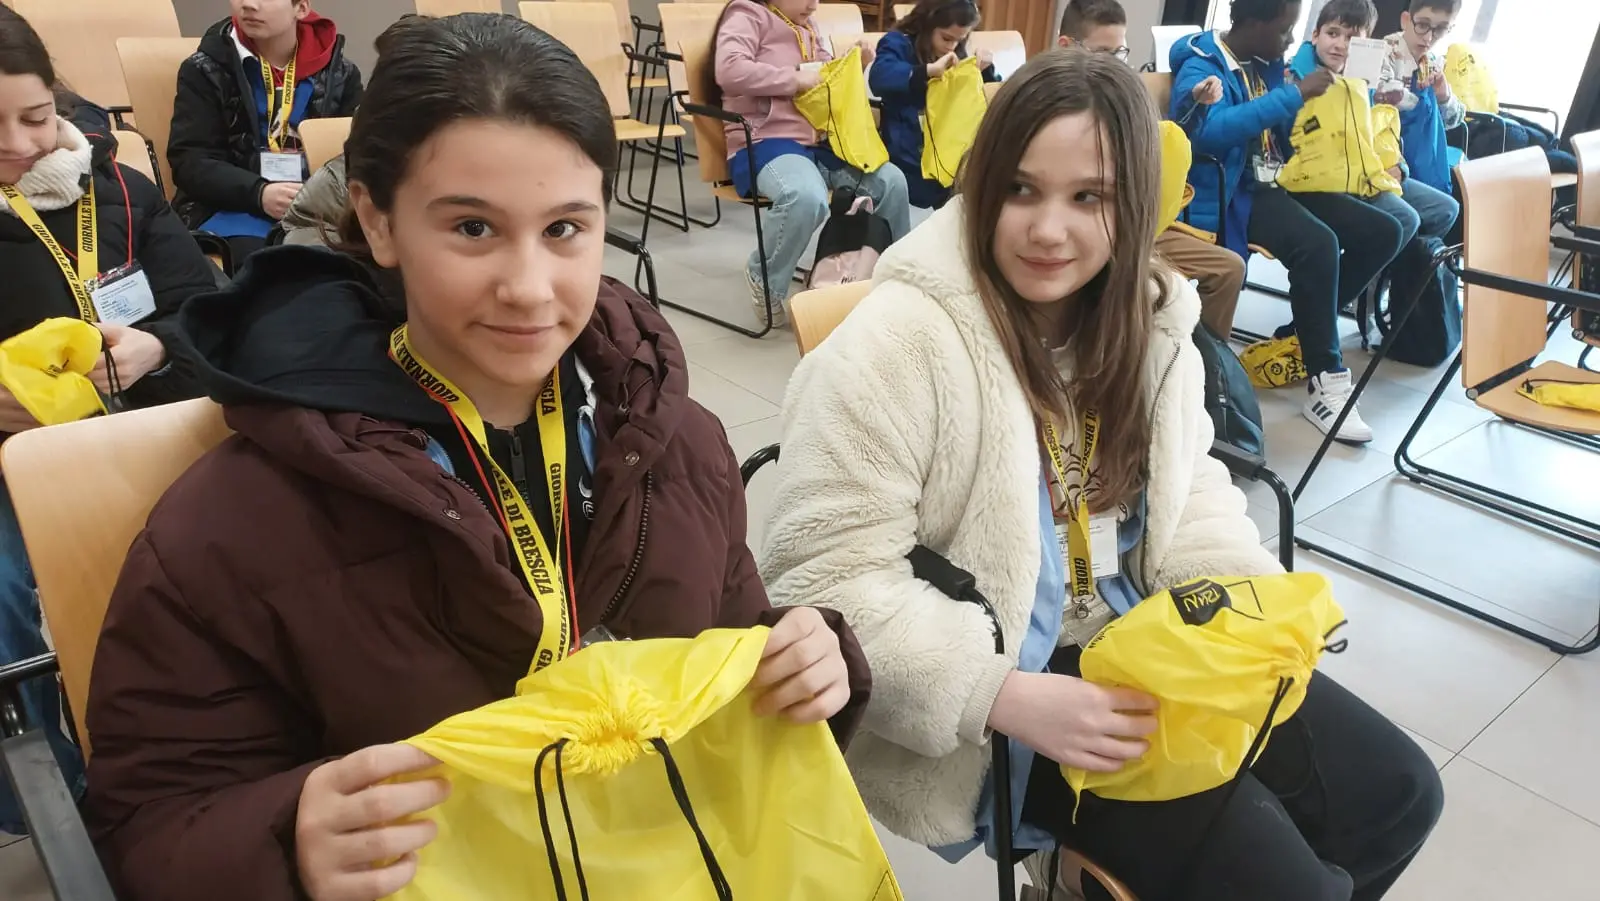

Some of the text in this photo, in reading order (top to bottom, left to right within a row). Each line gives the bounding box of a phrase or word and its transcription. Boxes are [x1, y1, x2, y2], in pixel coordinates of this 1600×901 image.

[32, 224, 70, 271] GIORNALE
[83, 207, 93, 252] GIORNALE
[506, 503, 524, 522] DI
[513, 524, 554, 595] BRESCIA
